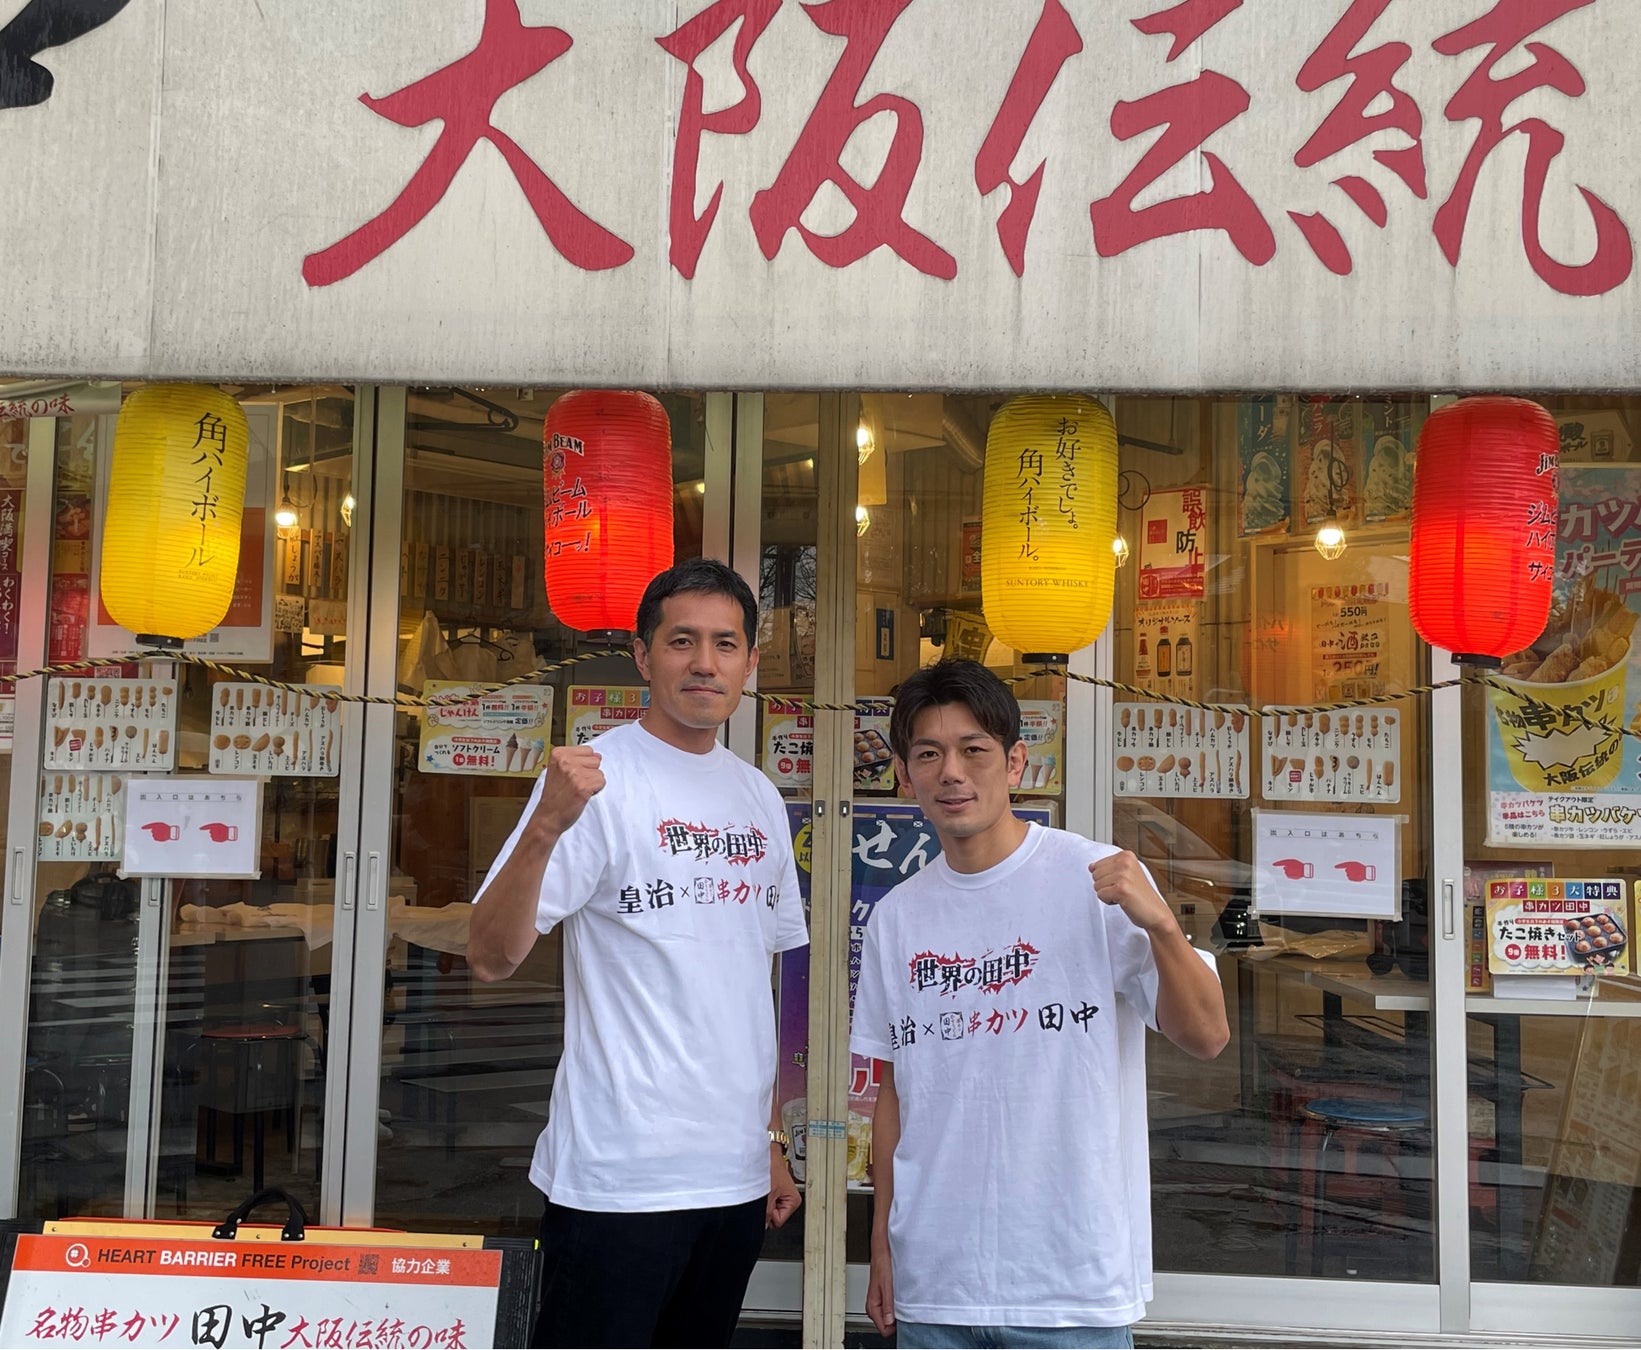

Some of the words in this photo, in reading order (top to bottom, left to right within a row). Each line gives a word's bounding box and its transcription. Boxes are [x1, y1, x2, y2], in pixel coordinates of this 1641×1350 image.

[554, 434, 583, 454] BEAM
[192, 412, 227, 568] 角ハイボール
[1055, 417, 1081, 529] お好きでしょ。
[1016, 448, 1044, 561] 角ハイボール。
[1053, 578, 1088, 588] WHISKY
[452, 744, 501, 754] ソフトクリーム
[1549, 804, 1641, 825] 串カツバケ
[667, 825, 764, 860] 世界の田中
[617, 878, 676, 914] 皇治
[916, 947, 1030, 993] 世界の田中
[967, 1008, 1029, 1038] 串カツ
[1038, 1001, 1099, 1033] 田中
[98, 1249, 156, 1263] HEART
[160, 1250, 237, 1267] BARRIER
[241, 1254, 286, 1269] FREE
[291, 1256, 351, 1273] Project
[392, 1258, 451, 1275] 協力企業
[25, 1306, 180, 1342] 名物串カツ
[281, 1315, 467, 1349] 大阪伝統の味
